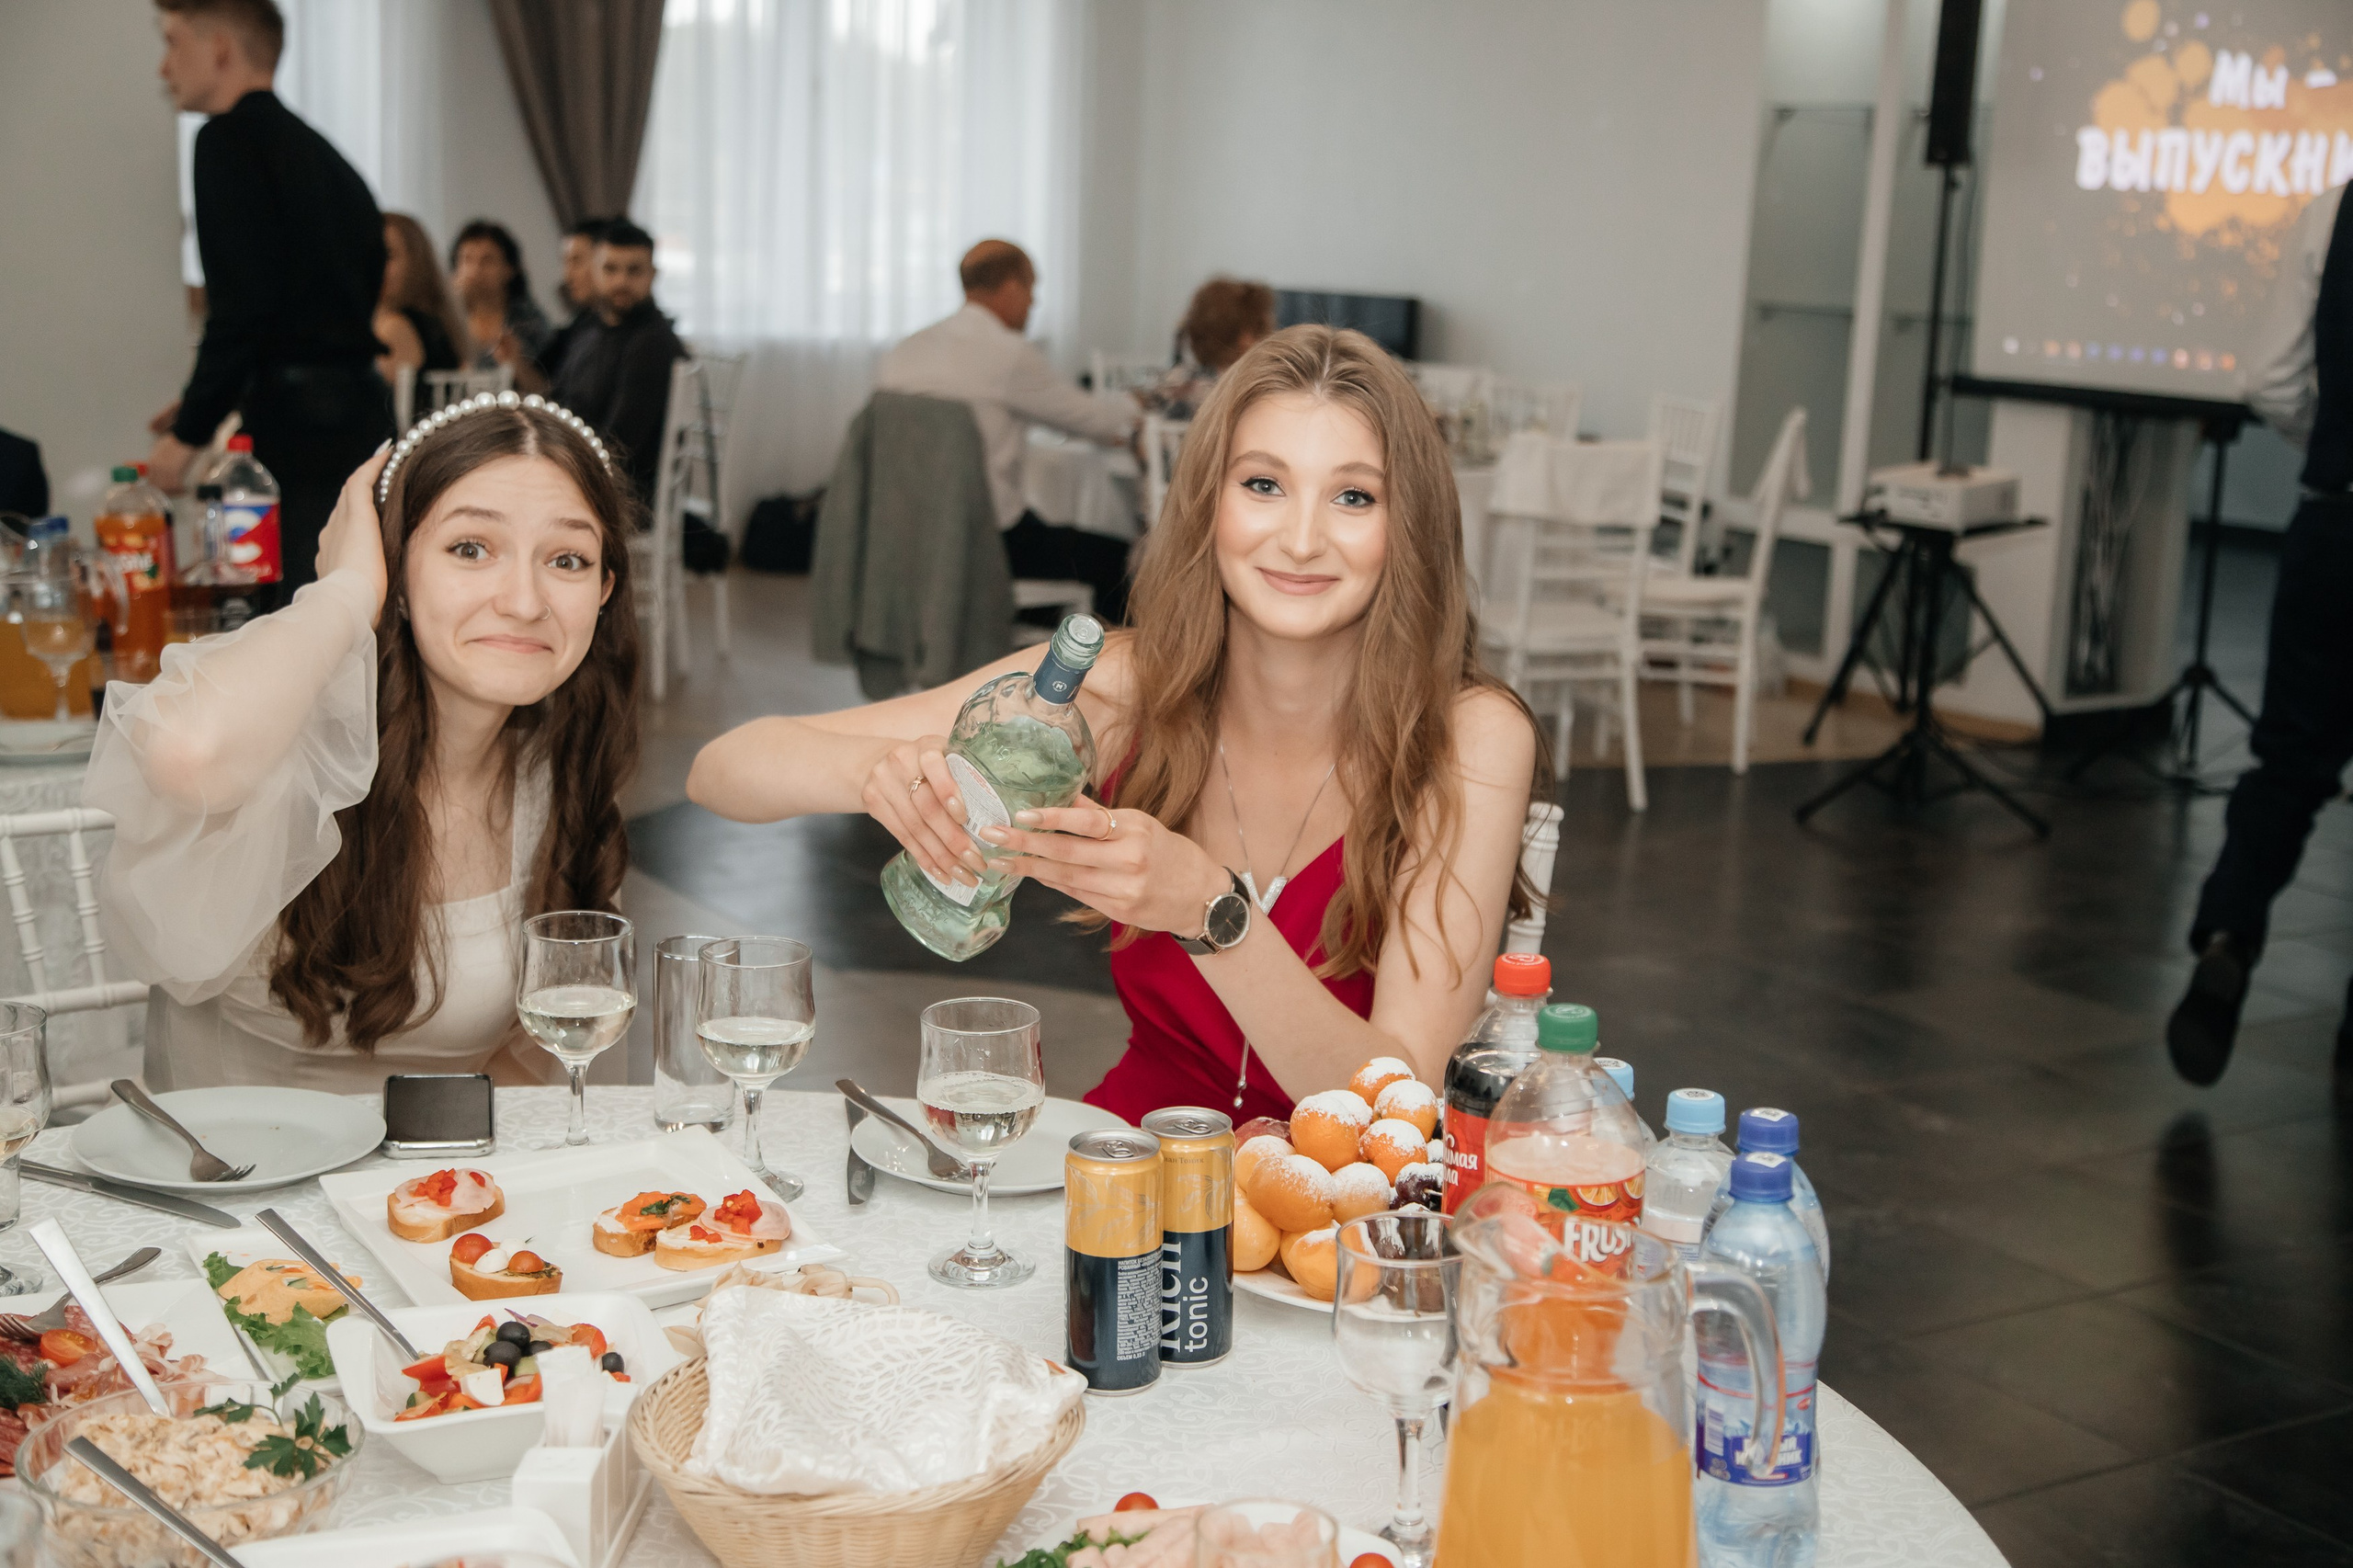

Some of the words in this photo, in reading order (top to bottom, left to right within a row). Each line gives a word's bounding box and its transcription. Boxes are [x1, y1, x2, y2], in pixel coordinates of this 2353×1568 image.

[2210, 49, 2289, 109] Мы
[1444, 1148, 1478, 1170] имая
[1183, 1277, 1209, 1353] tonic
